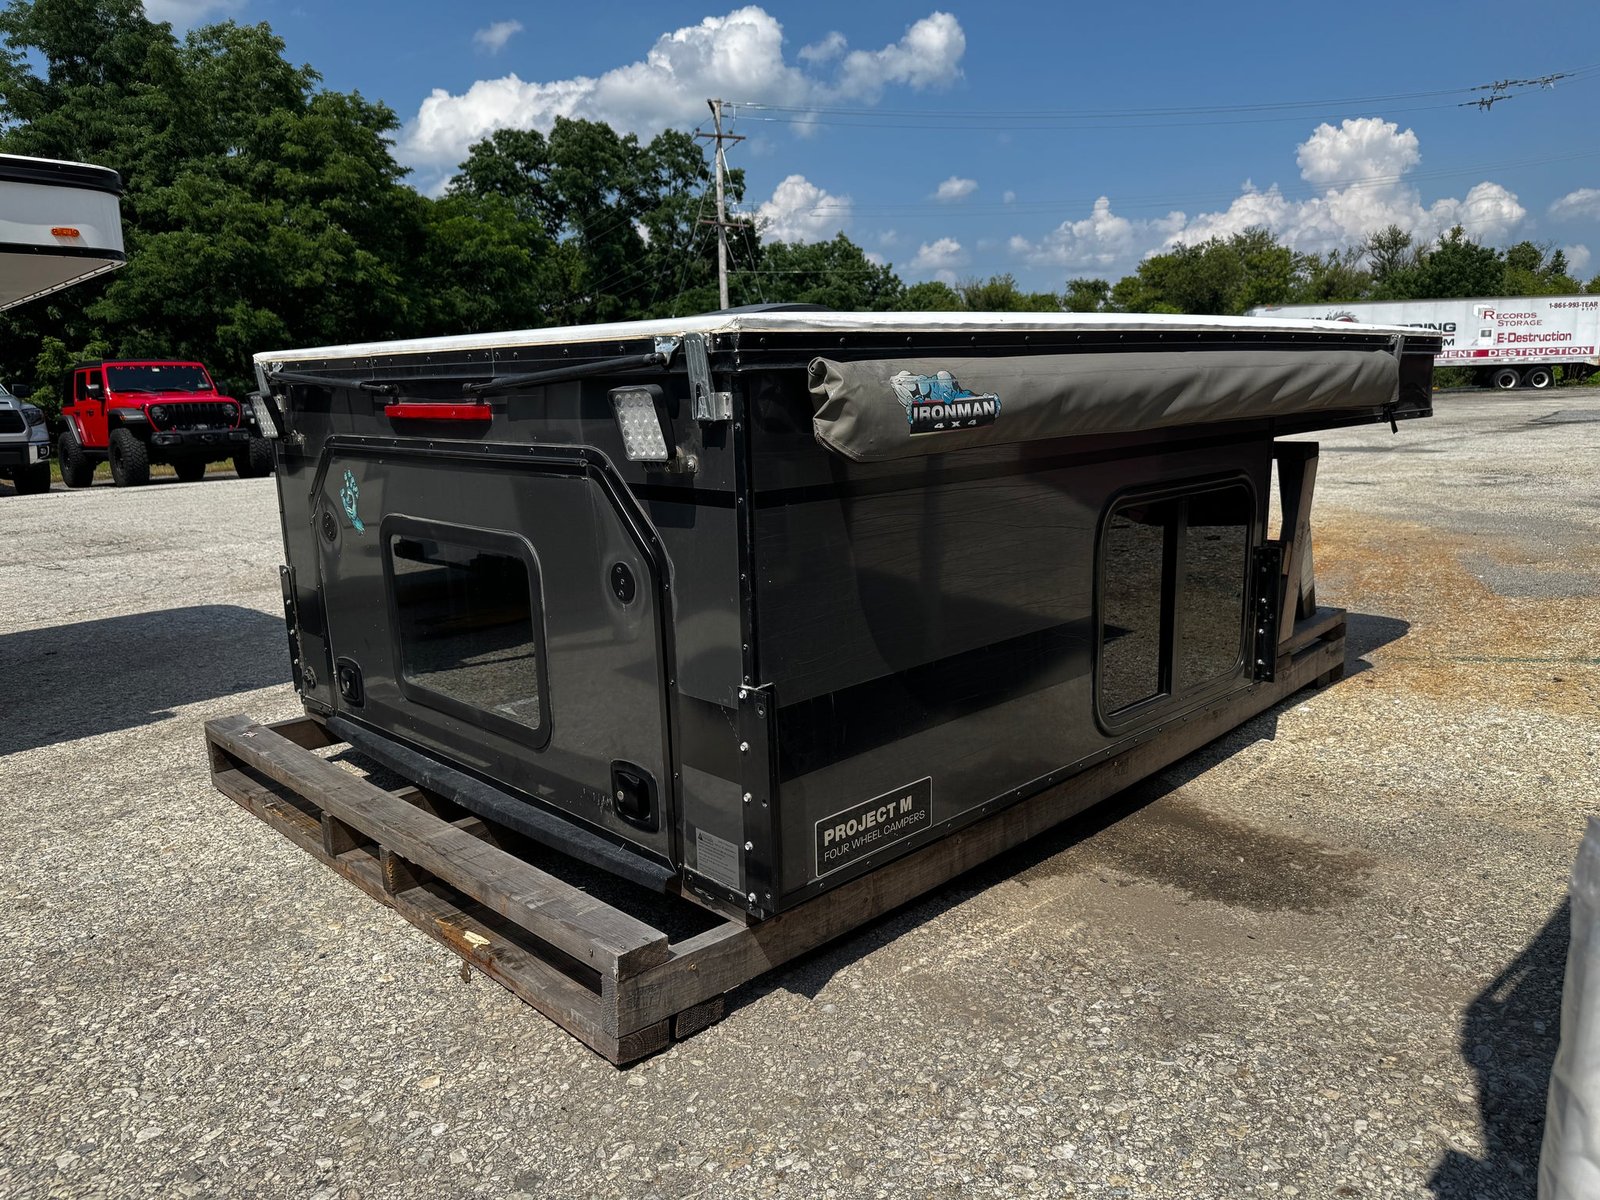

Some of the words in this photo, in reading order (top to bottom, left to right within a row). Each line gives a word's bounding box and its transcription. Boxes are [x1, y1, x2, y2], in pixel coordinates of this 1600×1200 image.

[1483, 310, 1537, 319] RECORDS
[1497, 331, 1571, 343] E-Destruction
[1488, 347, 1590, 356] DESTRUCTION
[913, 401, 995, 421] IRONMAN
[824, 802, 896, 847] PROJECT
[900, 795, 912, 814] M
[824, 842, 850, 862] FOUR
[851, 828, 882, 849] WHEEL
[883, 810, 926, 835] CAMPERS
